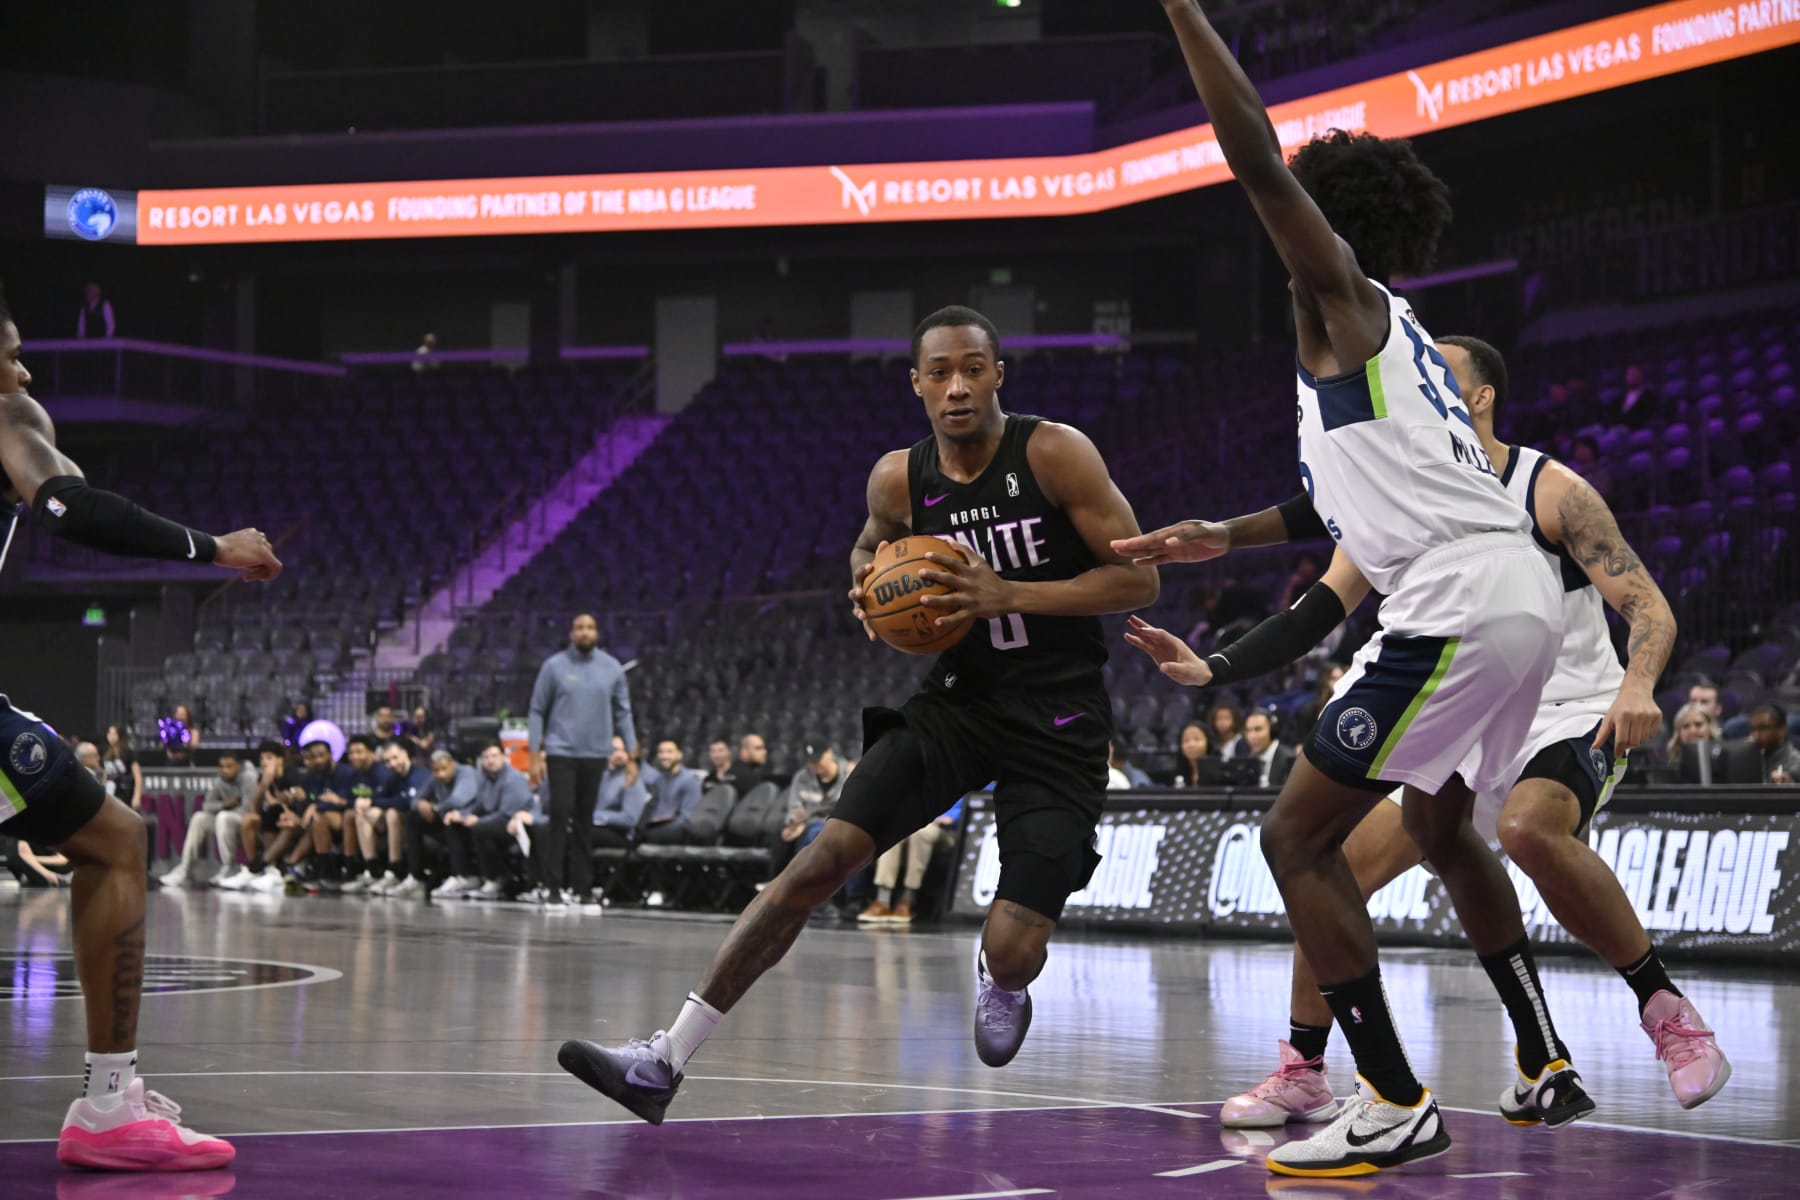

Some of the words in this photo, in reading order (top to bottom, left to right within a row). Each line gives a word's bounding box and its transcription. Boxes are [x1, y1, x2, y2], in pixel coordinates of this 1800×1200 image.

[1447, 62, 1523, 105] RESORT
[1526, 52, 1564, 87] LAS
[1567, 32, 1642, 75] VEGAS
[1652, 6, 1736, 56] FOUNDING
[149, 204, 239, 229] RESORT
[245, 202, 287, 226] LAS
[292, 200, 375, 224] VEGAS
[388, 194, 478, 222] FOUNDING
[480, 191, 561, 218] PARTNER
[563, 190, 587, 216] OF
[591, 189, 625, 214] THE
[628, 188, 668, 214] NBA
[669, 187, 684, 213] G
[686, 184, 756, 212] LEAGUE
[883, 177, 983, 204] RESORT
[989, 175, 1037, 200] LAS
[1042, 167, 1116, 198] VEGAS
[950, 505, 1000, 526] NBAGL
[932, 516, 1050, 572] NITE
